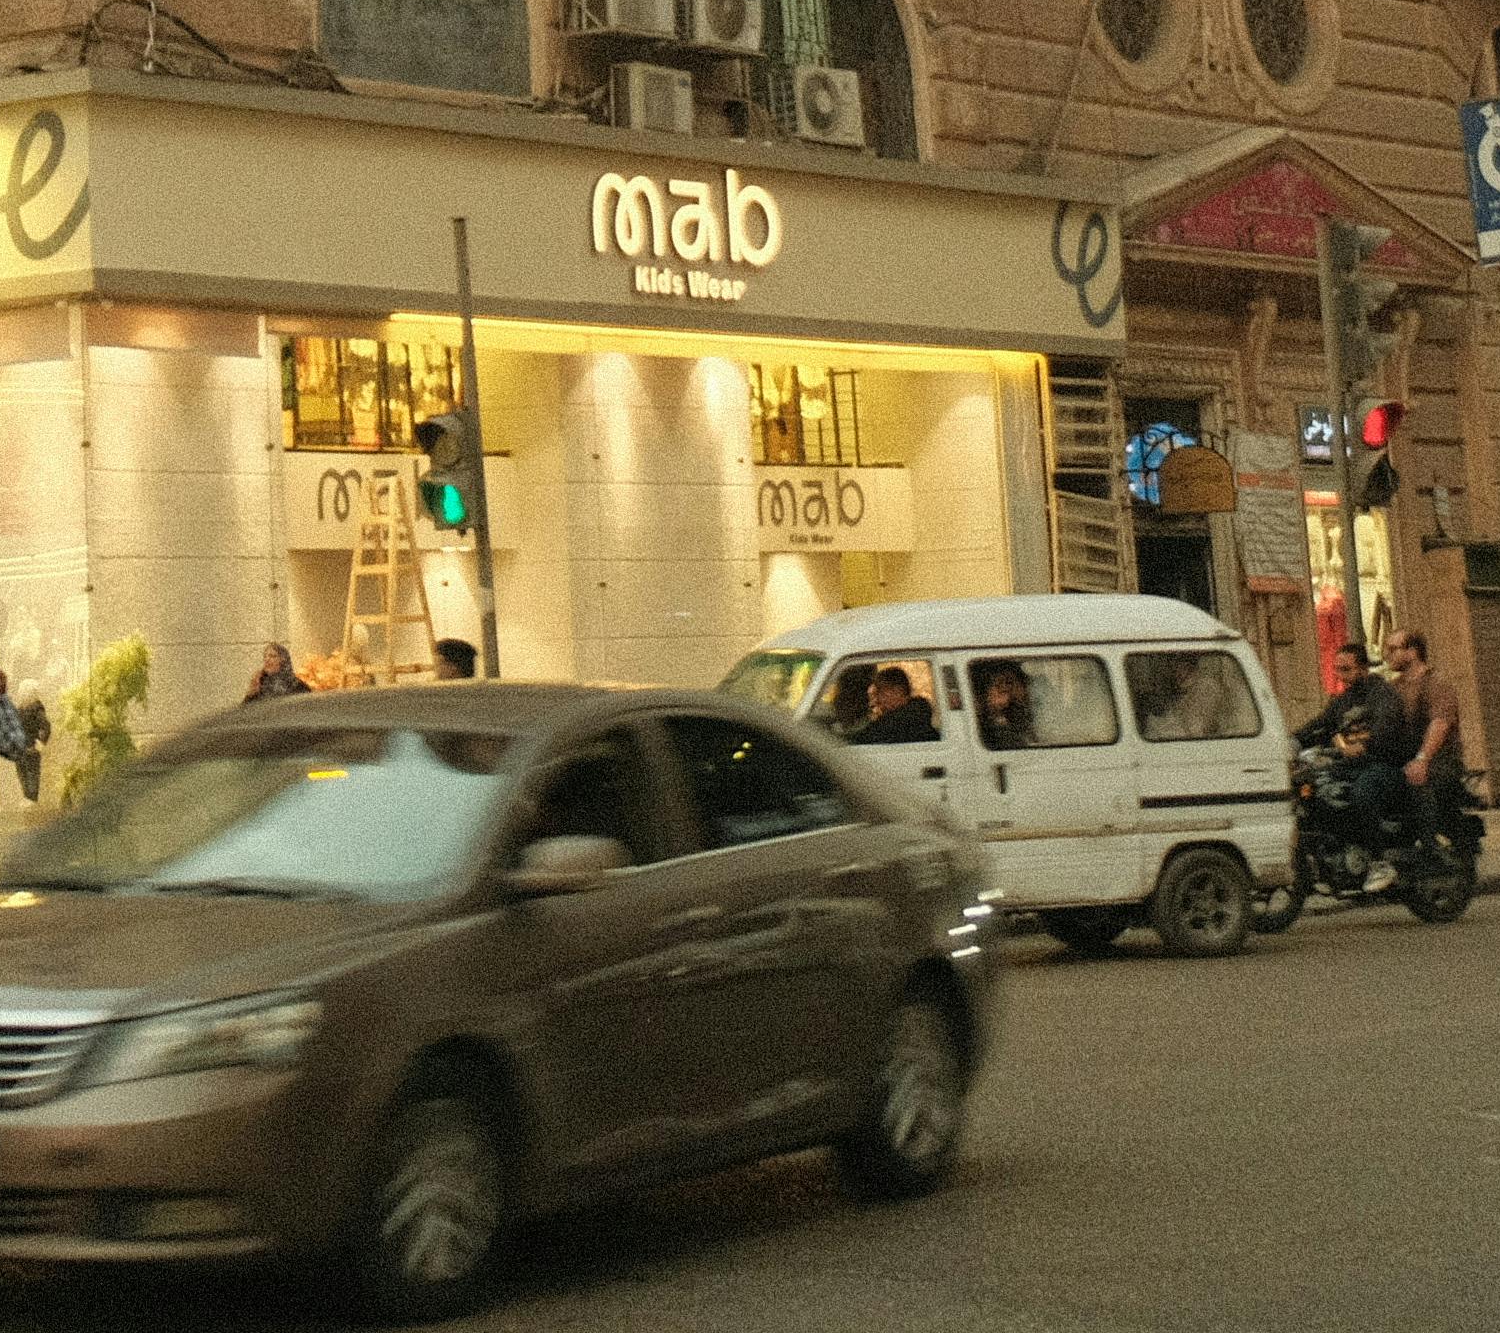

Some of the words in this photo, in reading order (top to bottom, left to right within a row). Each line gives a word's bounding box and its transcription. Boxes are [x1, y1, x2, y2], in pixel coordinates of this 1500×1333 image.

[591, 169, 784, 267] mab
[634, 265, 684, 297] Kids
[688, 269, 747, 302] Wear
[757, 470, 866, 528] mab
